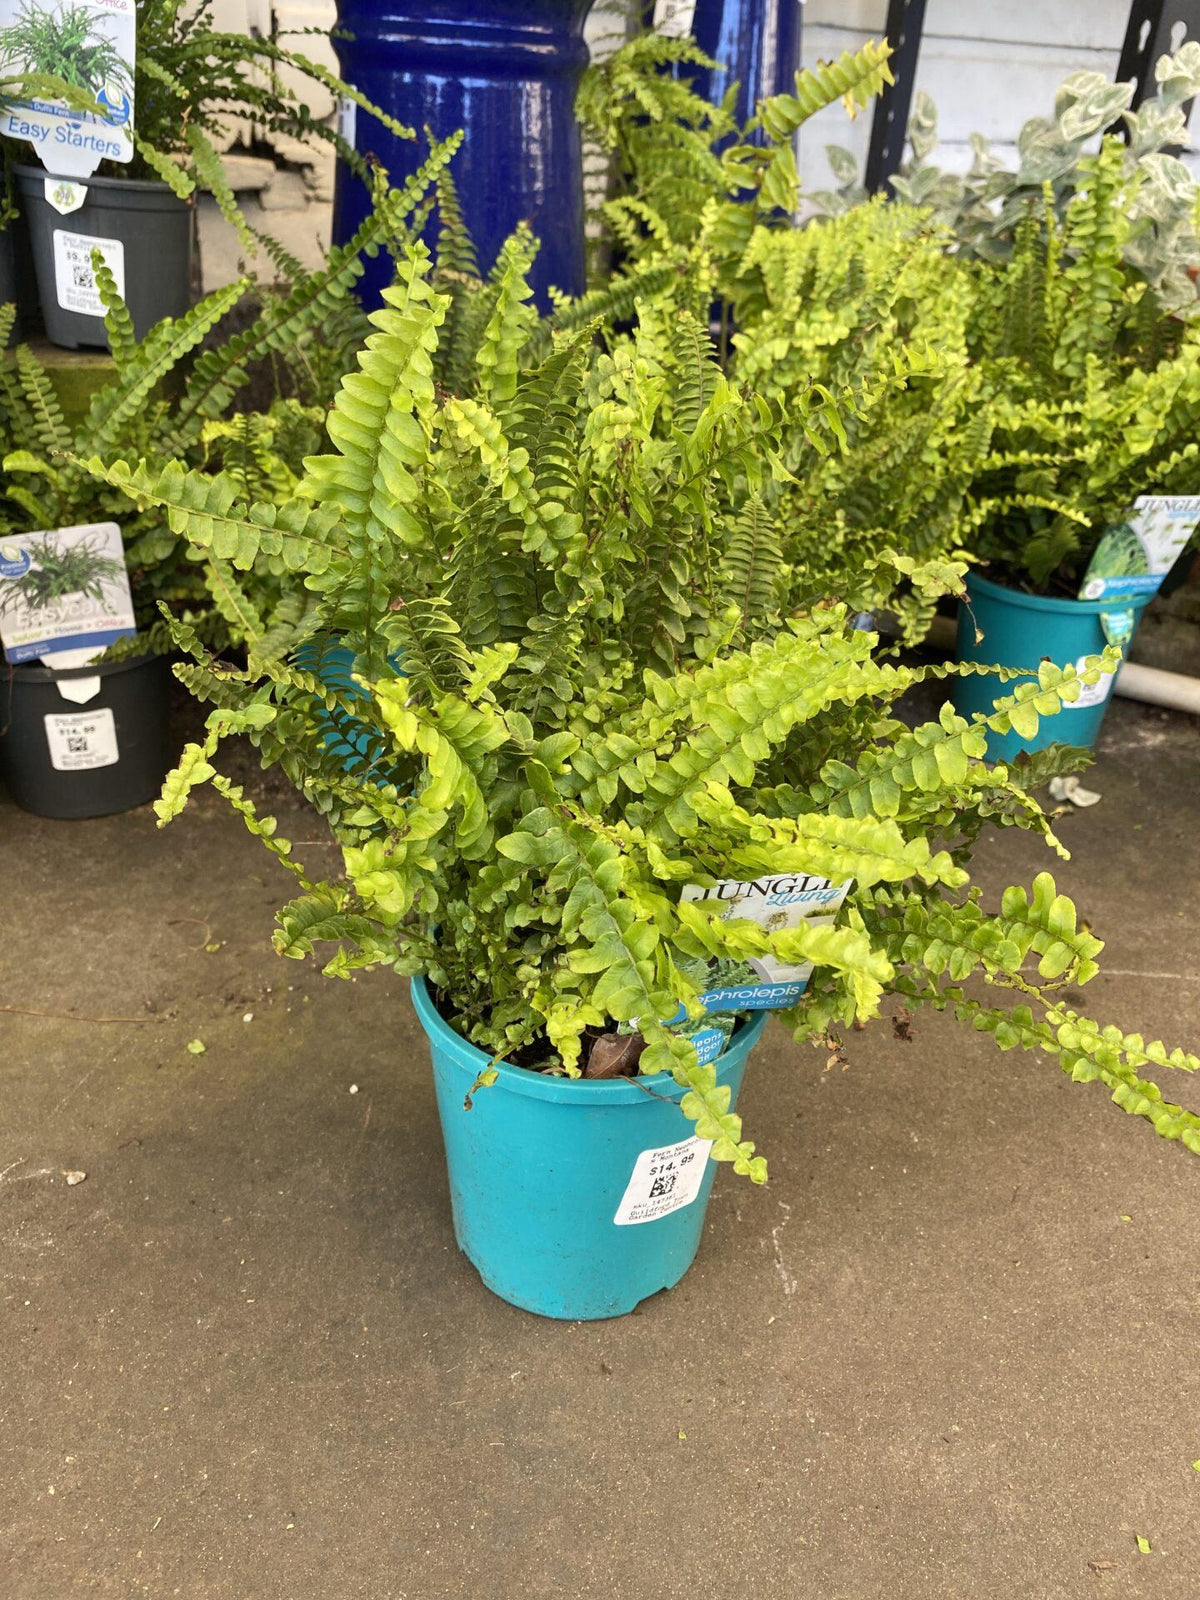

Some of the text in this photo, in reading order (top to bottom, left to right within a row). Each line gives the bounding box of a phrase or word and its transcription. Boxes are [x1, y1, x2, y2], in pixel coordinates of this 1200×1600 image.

[8, 115, 121, 156] Easy Starters
[766, 888, 840, 906] Living
[739, 998, 795, 1008] species
[693, 1032, 722, 1047] leans
[697, 1040, 721, 1055] door
[649, 1153, 695, 1176] $14.99
